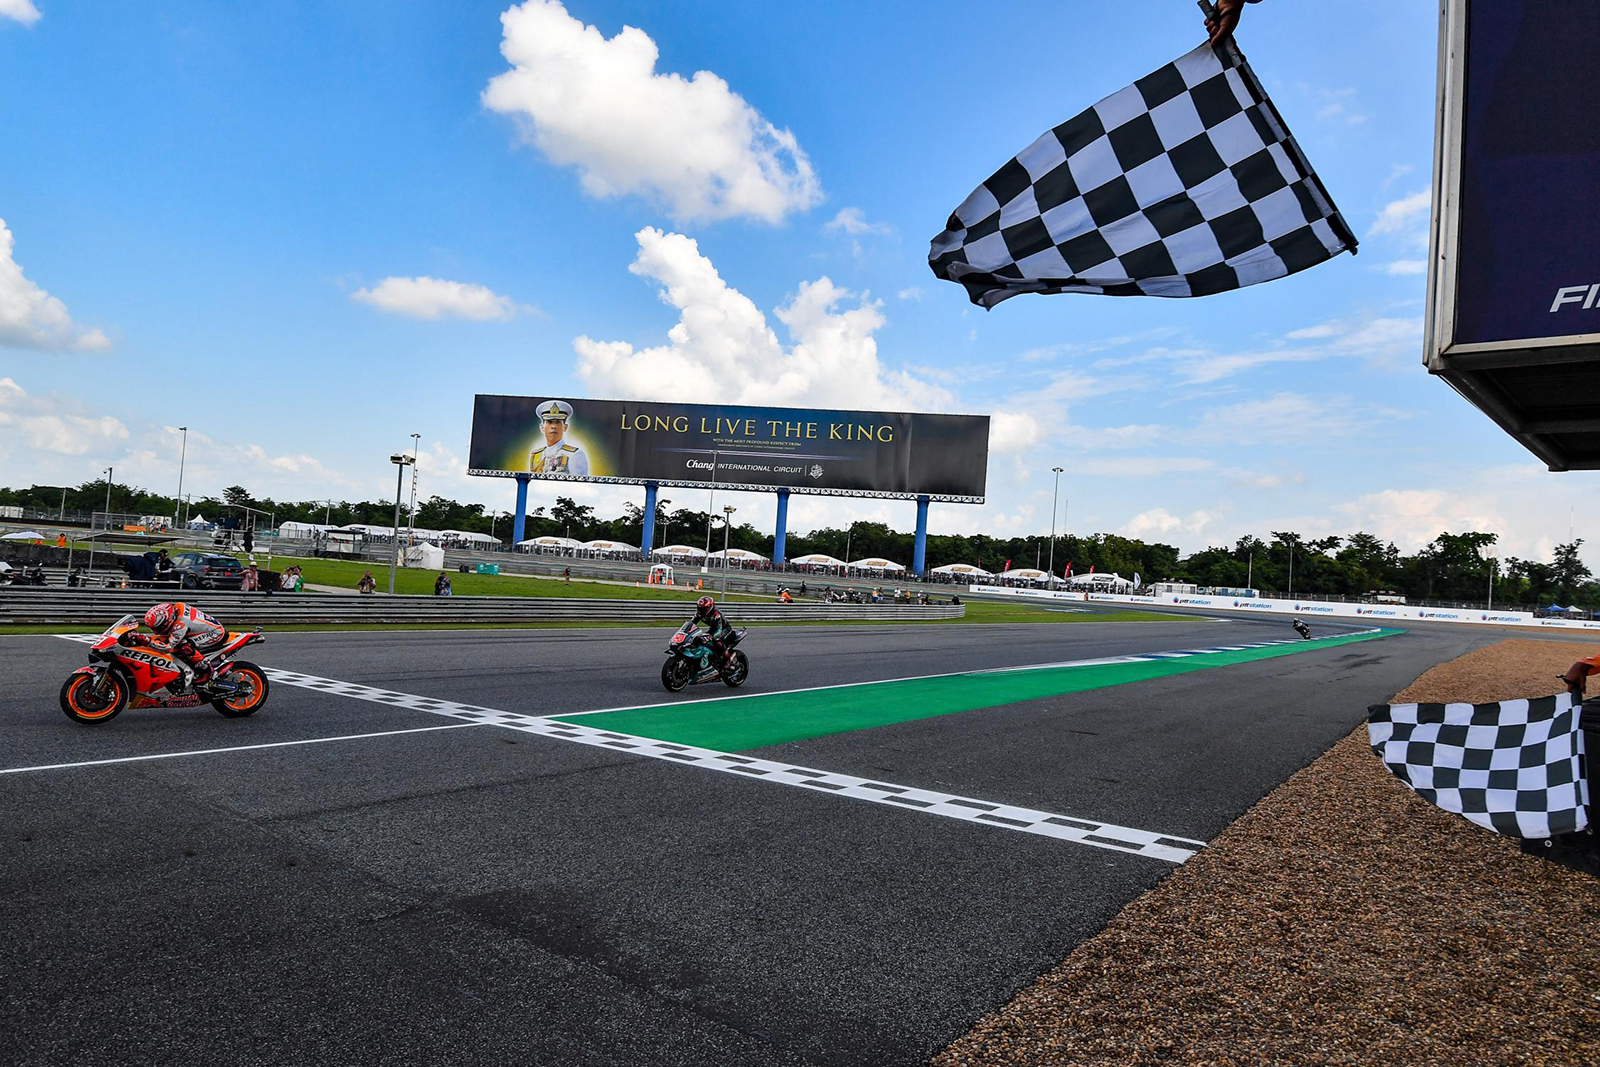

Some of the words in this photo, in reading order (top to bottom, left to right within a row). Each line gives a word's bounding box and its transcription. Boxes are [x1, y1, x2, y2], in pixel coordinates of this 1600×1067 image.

[1549, 283, 1600, 312] FI
[620, 413, 690, 433] LONG
[700, 417, 757, 436] LIVE
[766, 420, 818, 439] THE
[829, 423, 894, 443] KING
[685, 459, 715, 471] Chang
[717, 463, 771, 472] INTERNATIONAL
[773, 465, 803, 473] CIRCUIT
[120, 649, 174, 668] REPSOL
